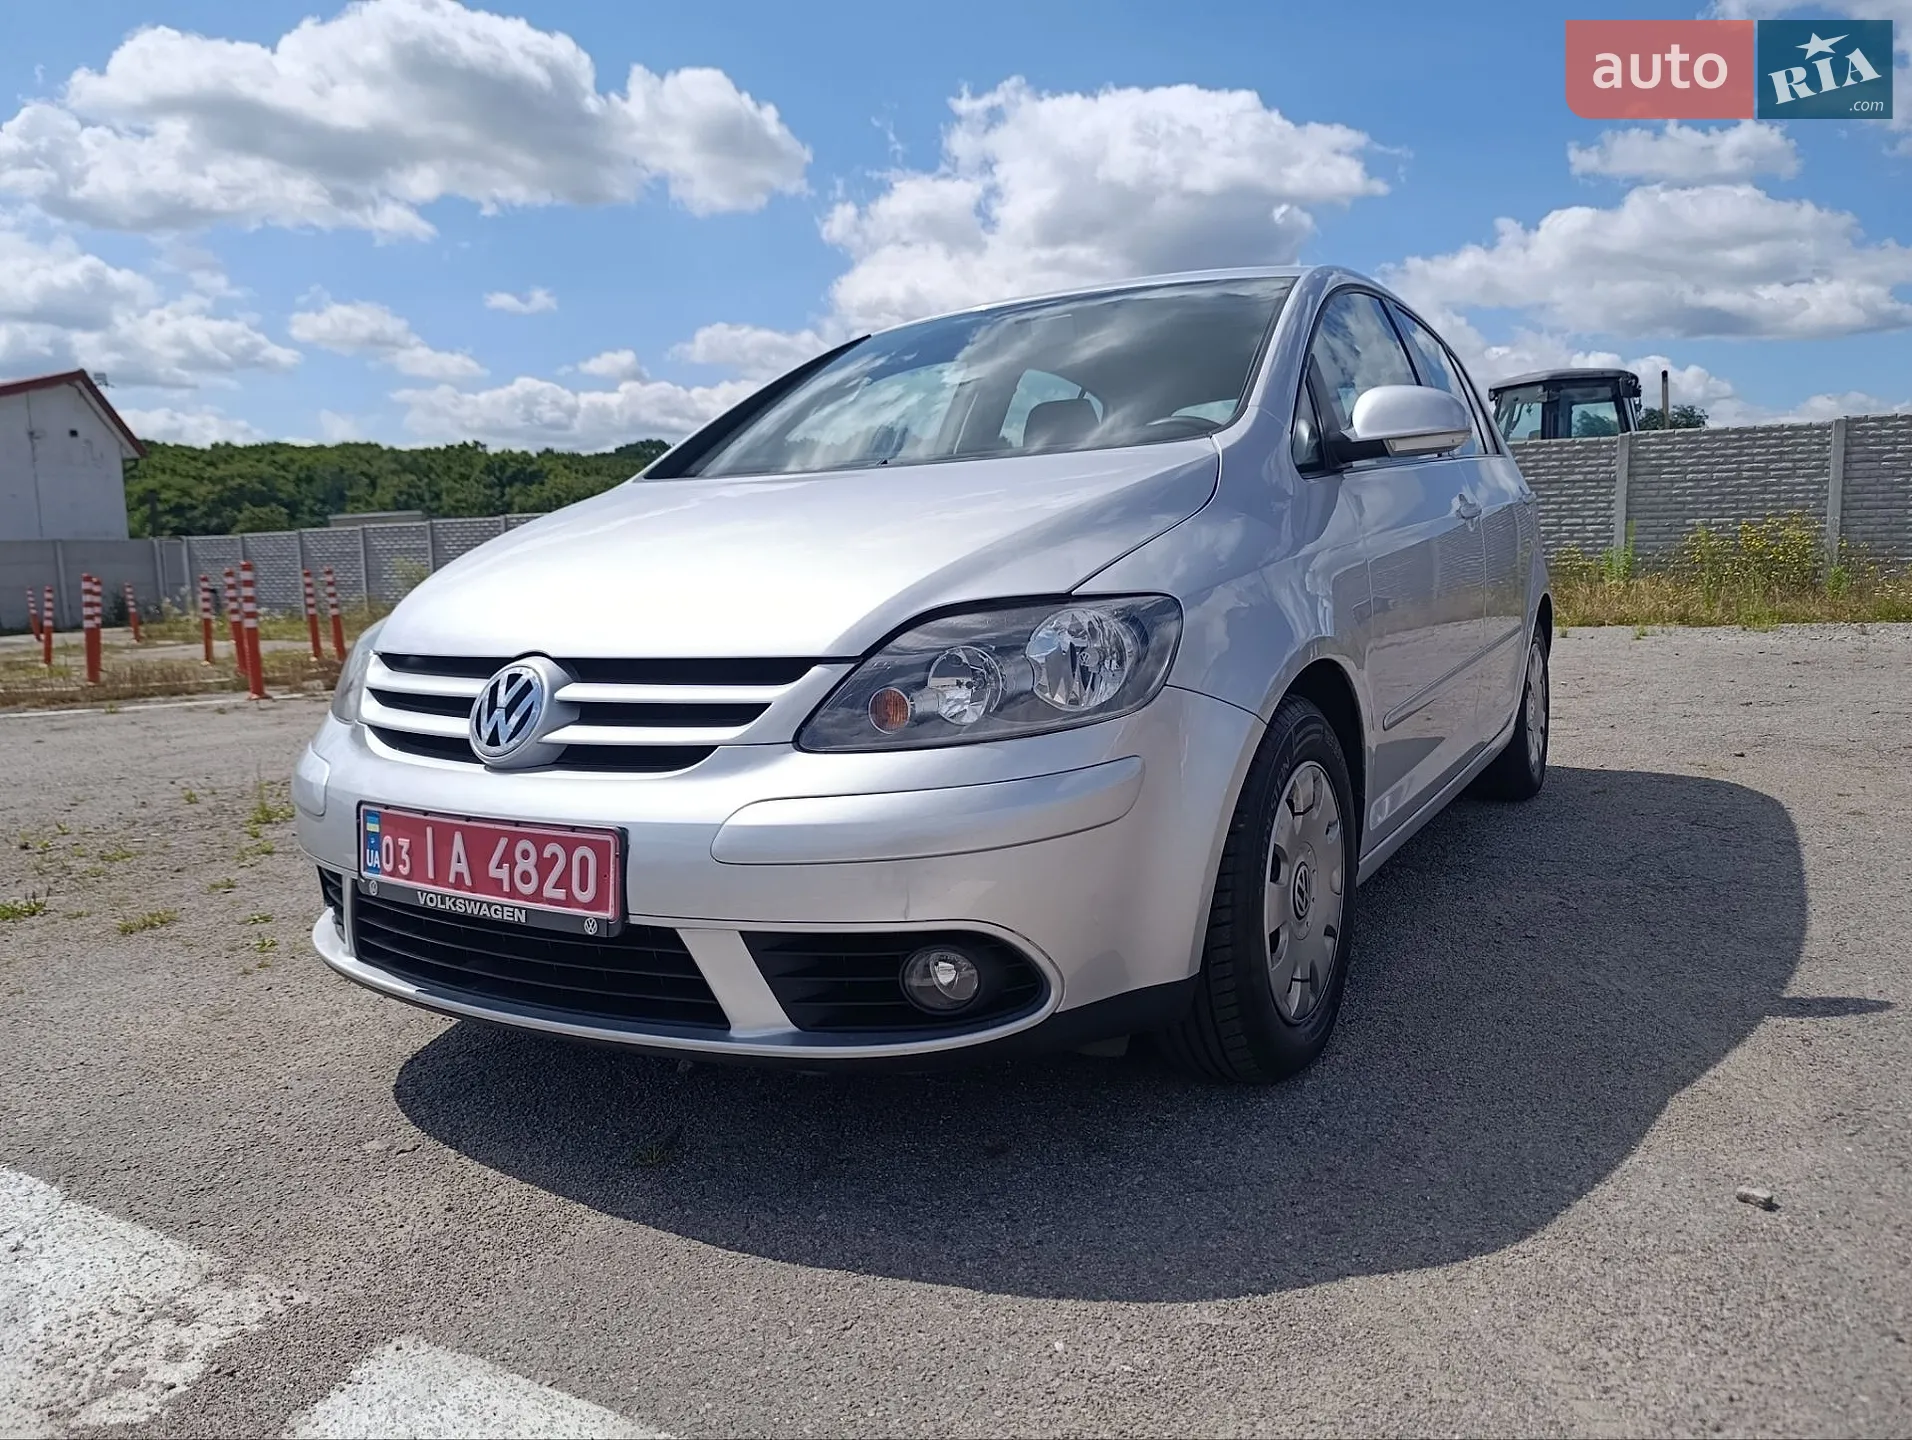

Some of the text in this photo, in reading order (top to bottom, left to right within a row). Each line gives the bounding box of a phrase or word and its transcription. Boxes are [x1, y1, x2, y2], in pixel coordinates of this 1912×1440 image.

[473, 667, 542, 756] VW
[366, 848, 381, 869] UA
[381, 825, 598, 904] 03 IA 4820
[416, 890, 527, 923] VOLKSWAGEN
